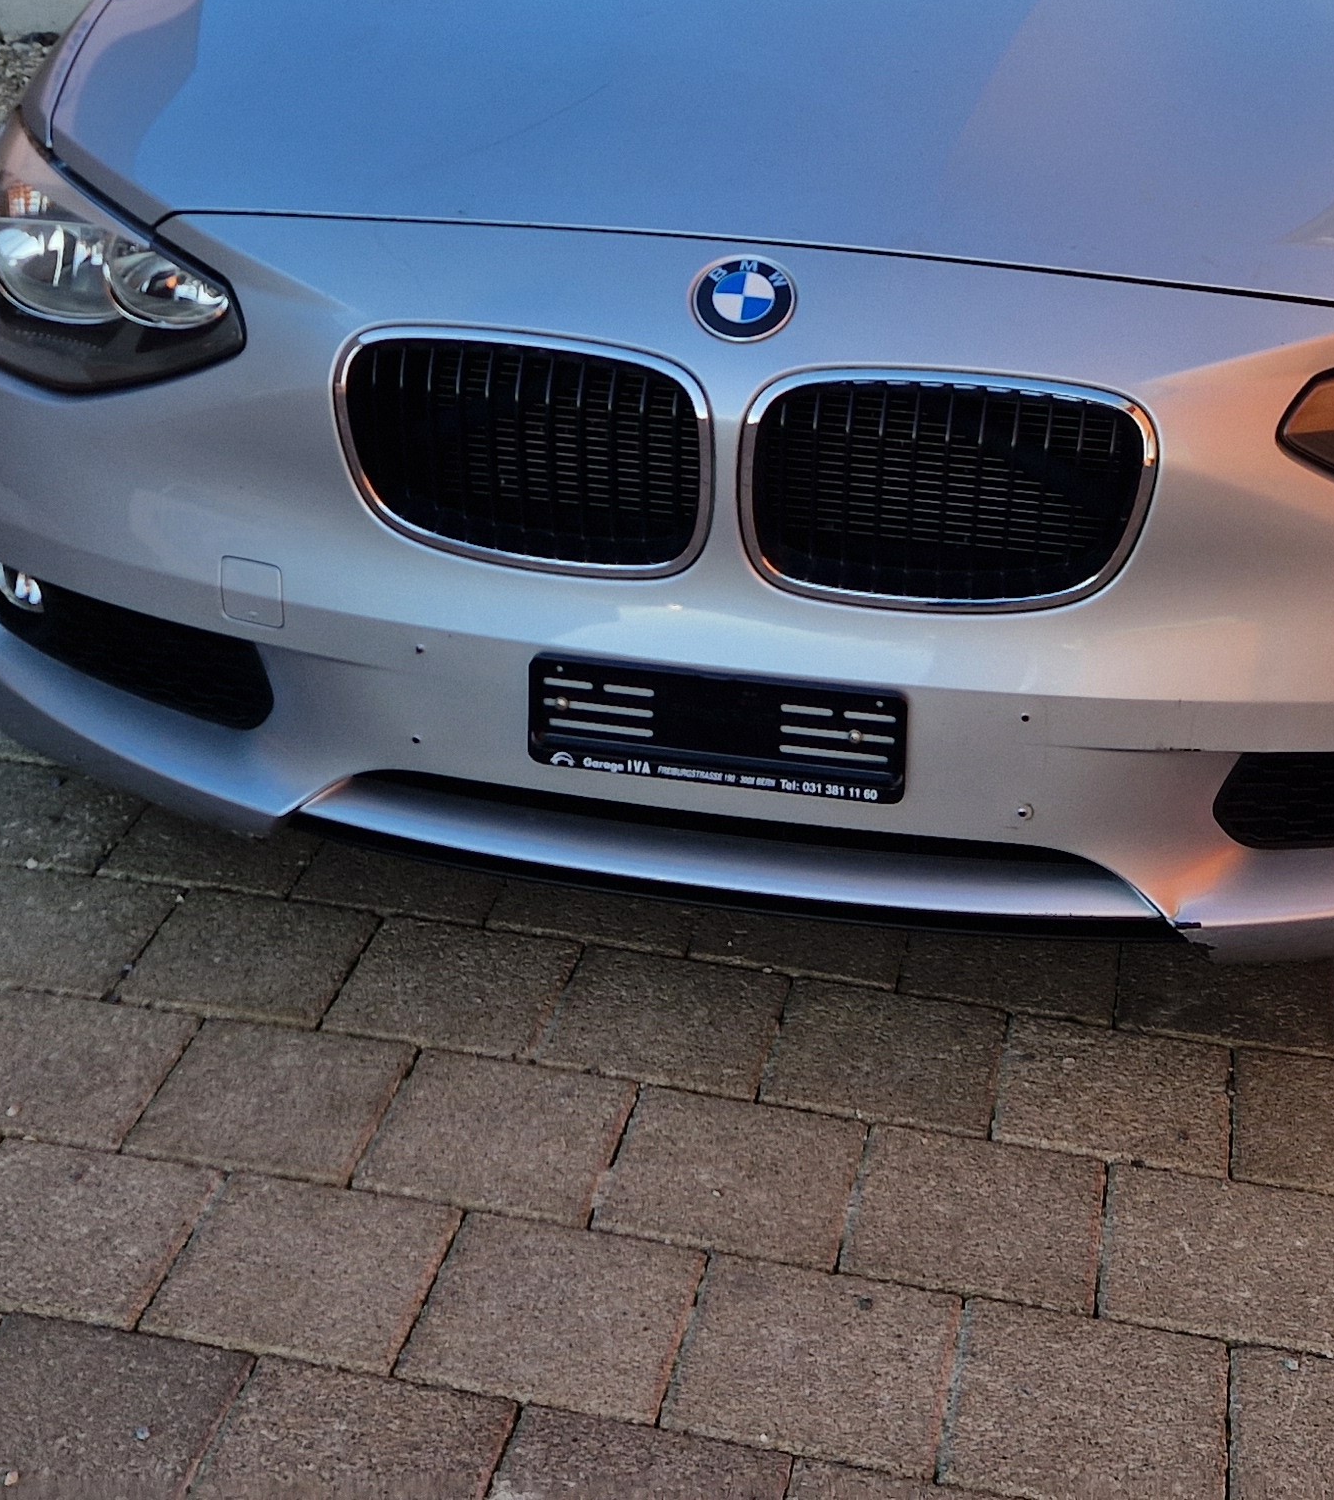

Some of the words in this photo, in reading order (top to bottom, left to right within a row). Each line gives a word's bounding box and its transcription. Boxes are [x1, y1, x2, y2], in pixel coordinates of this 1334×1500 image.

[708, 260, 788, 287] BMW
[583, 756, 624, 773] Garage
[627, 759, 651, 774] IVA
[780, 779, 800, 791] Tel:
[802, 781, 822, 793] 031
[825, 784, 845, 797] 381
[849, 787, 861, 799] 11
[863, 789, 879, 801] 60
